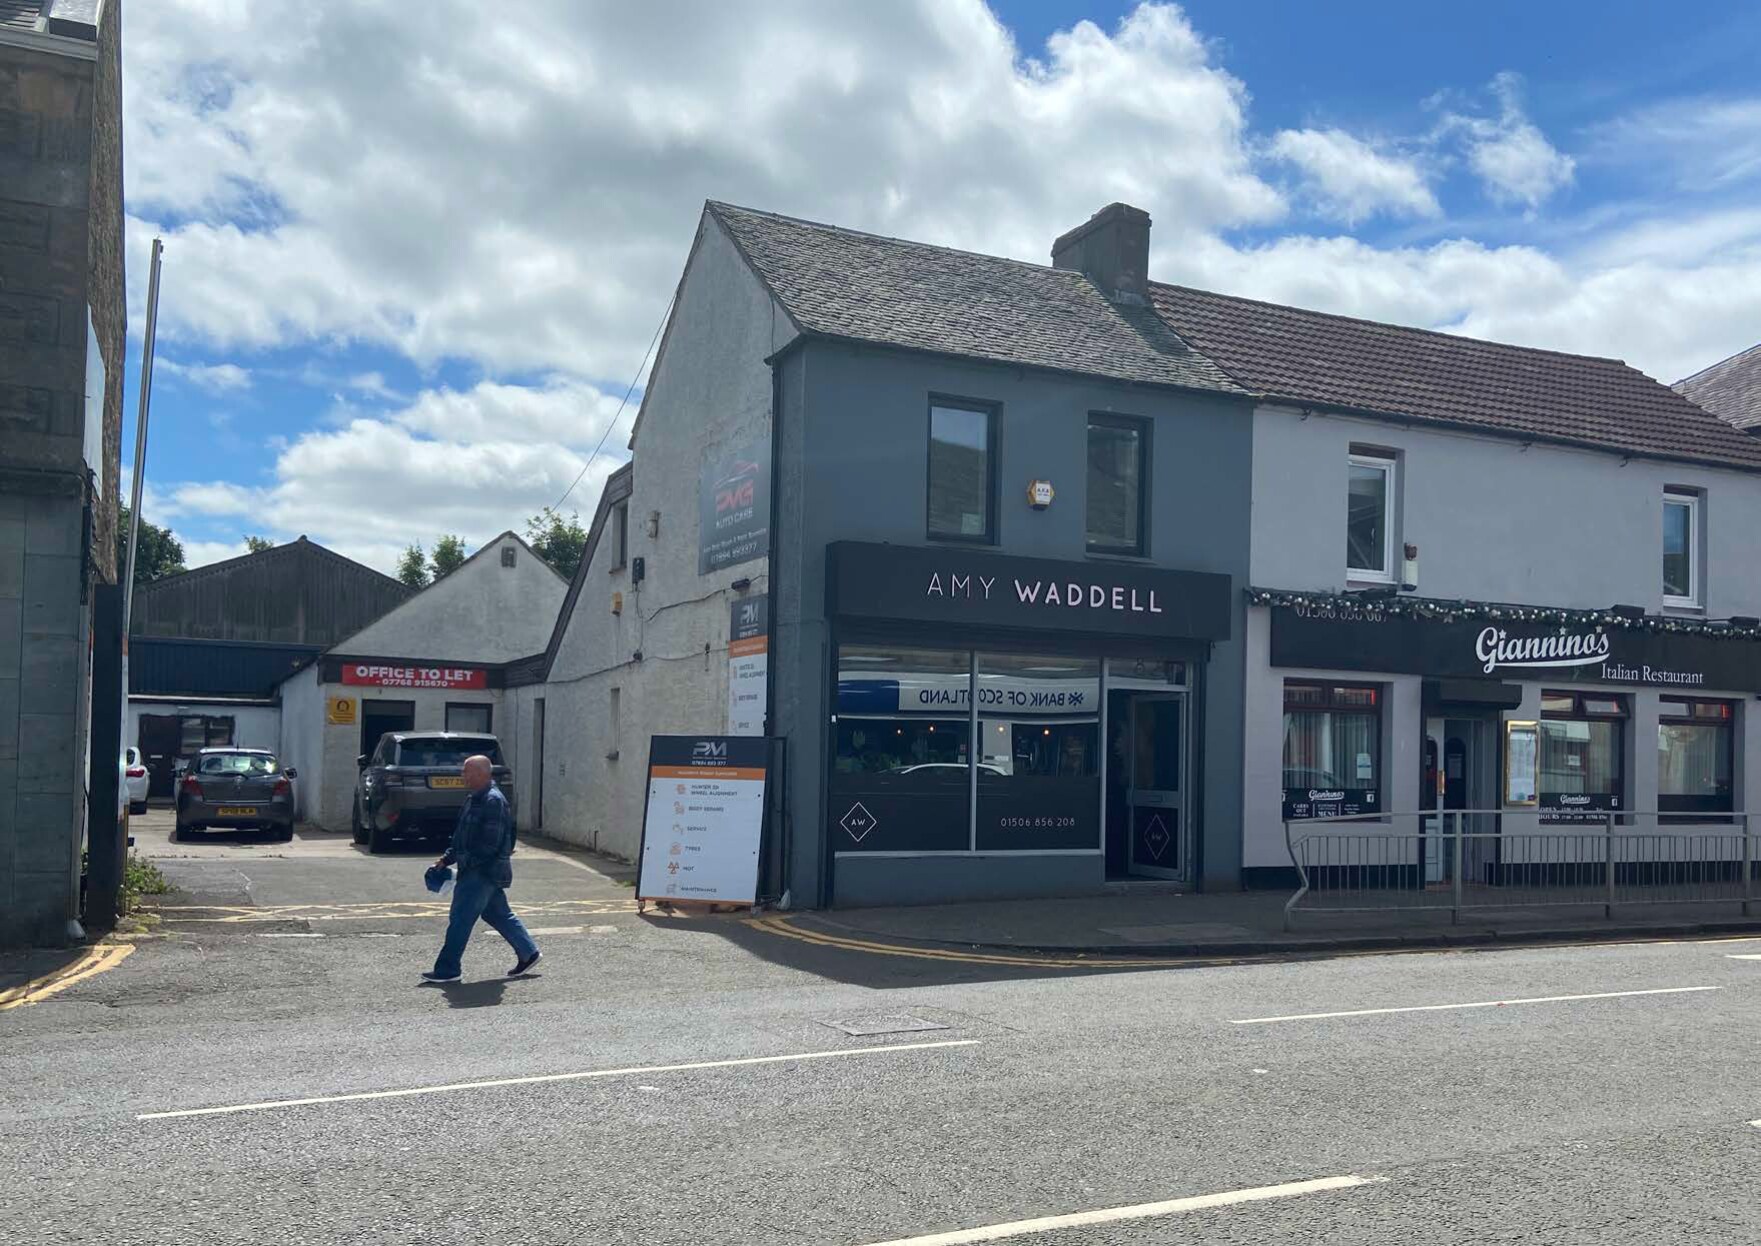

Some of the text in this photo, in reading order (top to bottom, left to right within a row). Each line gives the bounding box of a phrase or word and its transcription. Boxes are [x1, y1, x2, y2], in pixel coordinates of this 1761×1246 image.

[715, 507, 753, 528] AUTO CARE
[927, 572, 1162, 613] AMY WADDELL
[355, 666, 474, 681] OFFICE TO LET
[1601, 663, 1704, 684] Italian Restaurant
[693, 741, 728, 756] PM
[851, 818, 866, 826] AW
[1000, 817, 1075, 827] 01506 856 208
